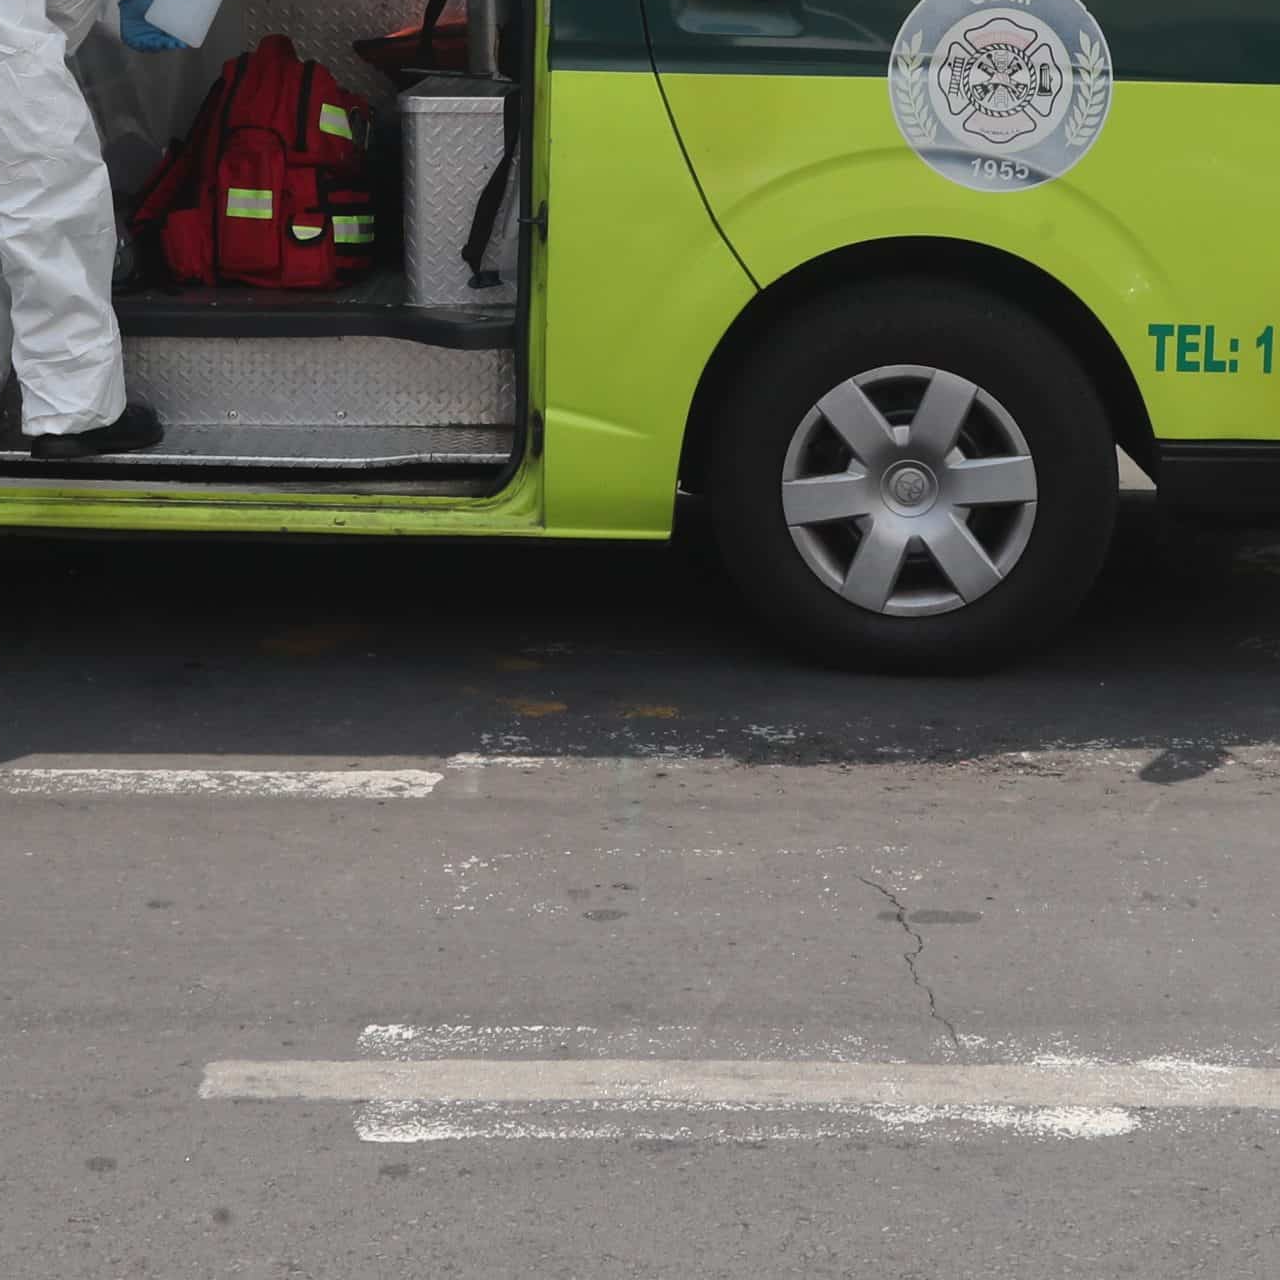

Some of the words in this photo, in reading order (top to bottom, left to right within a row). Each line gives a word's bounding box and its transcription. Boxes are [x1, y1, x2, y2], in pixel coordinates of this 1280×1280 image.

[970, 157, 1030, 181] 1955
[1148, 323, 1239, 374] TEL:
[1256, 325, 1273, 374] 1
